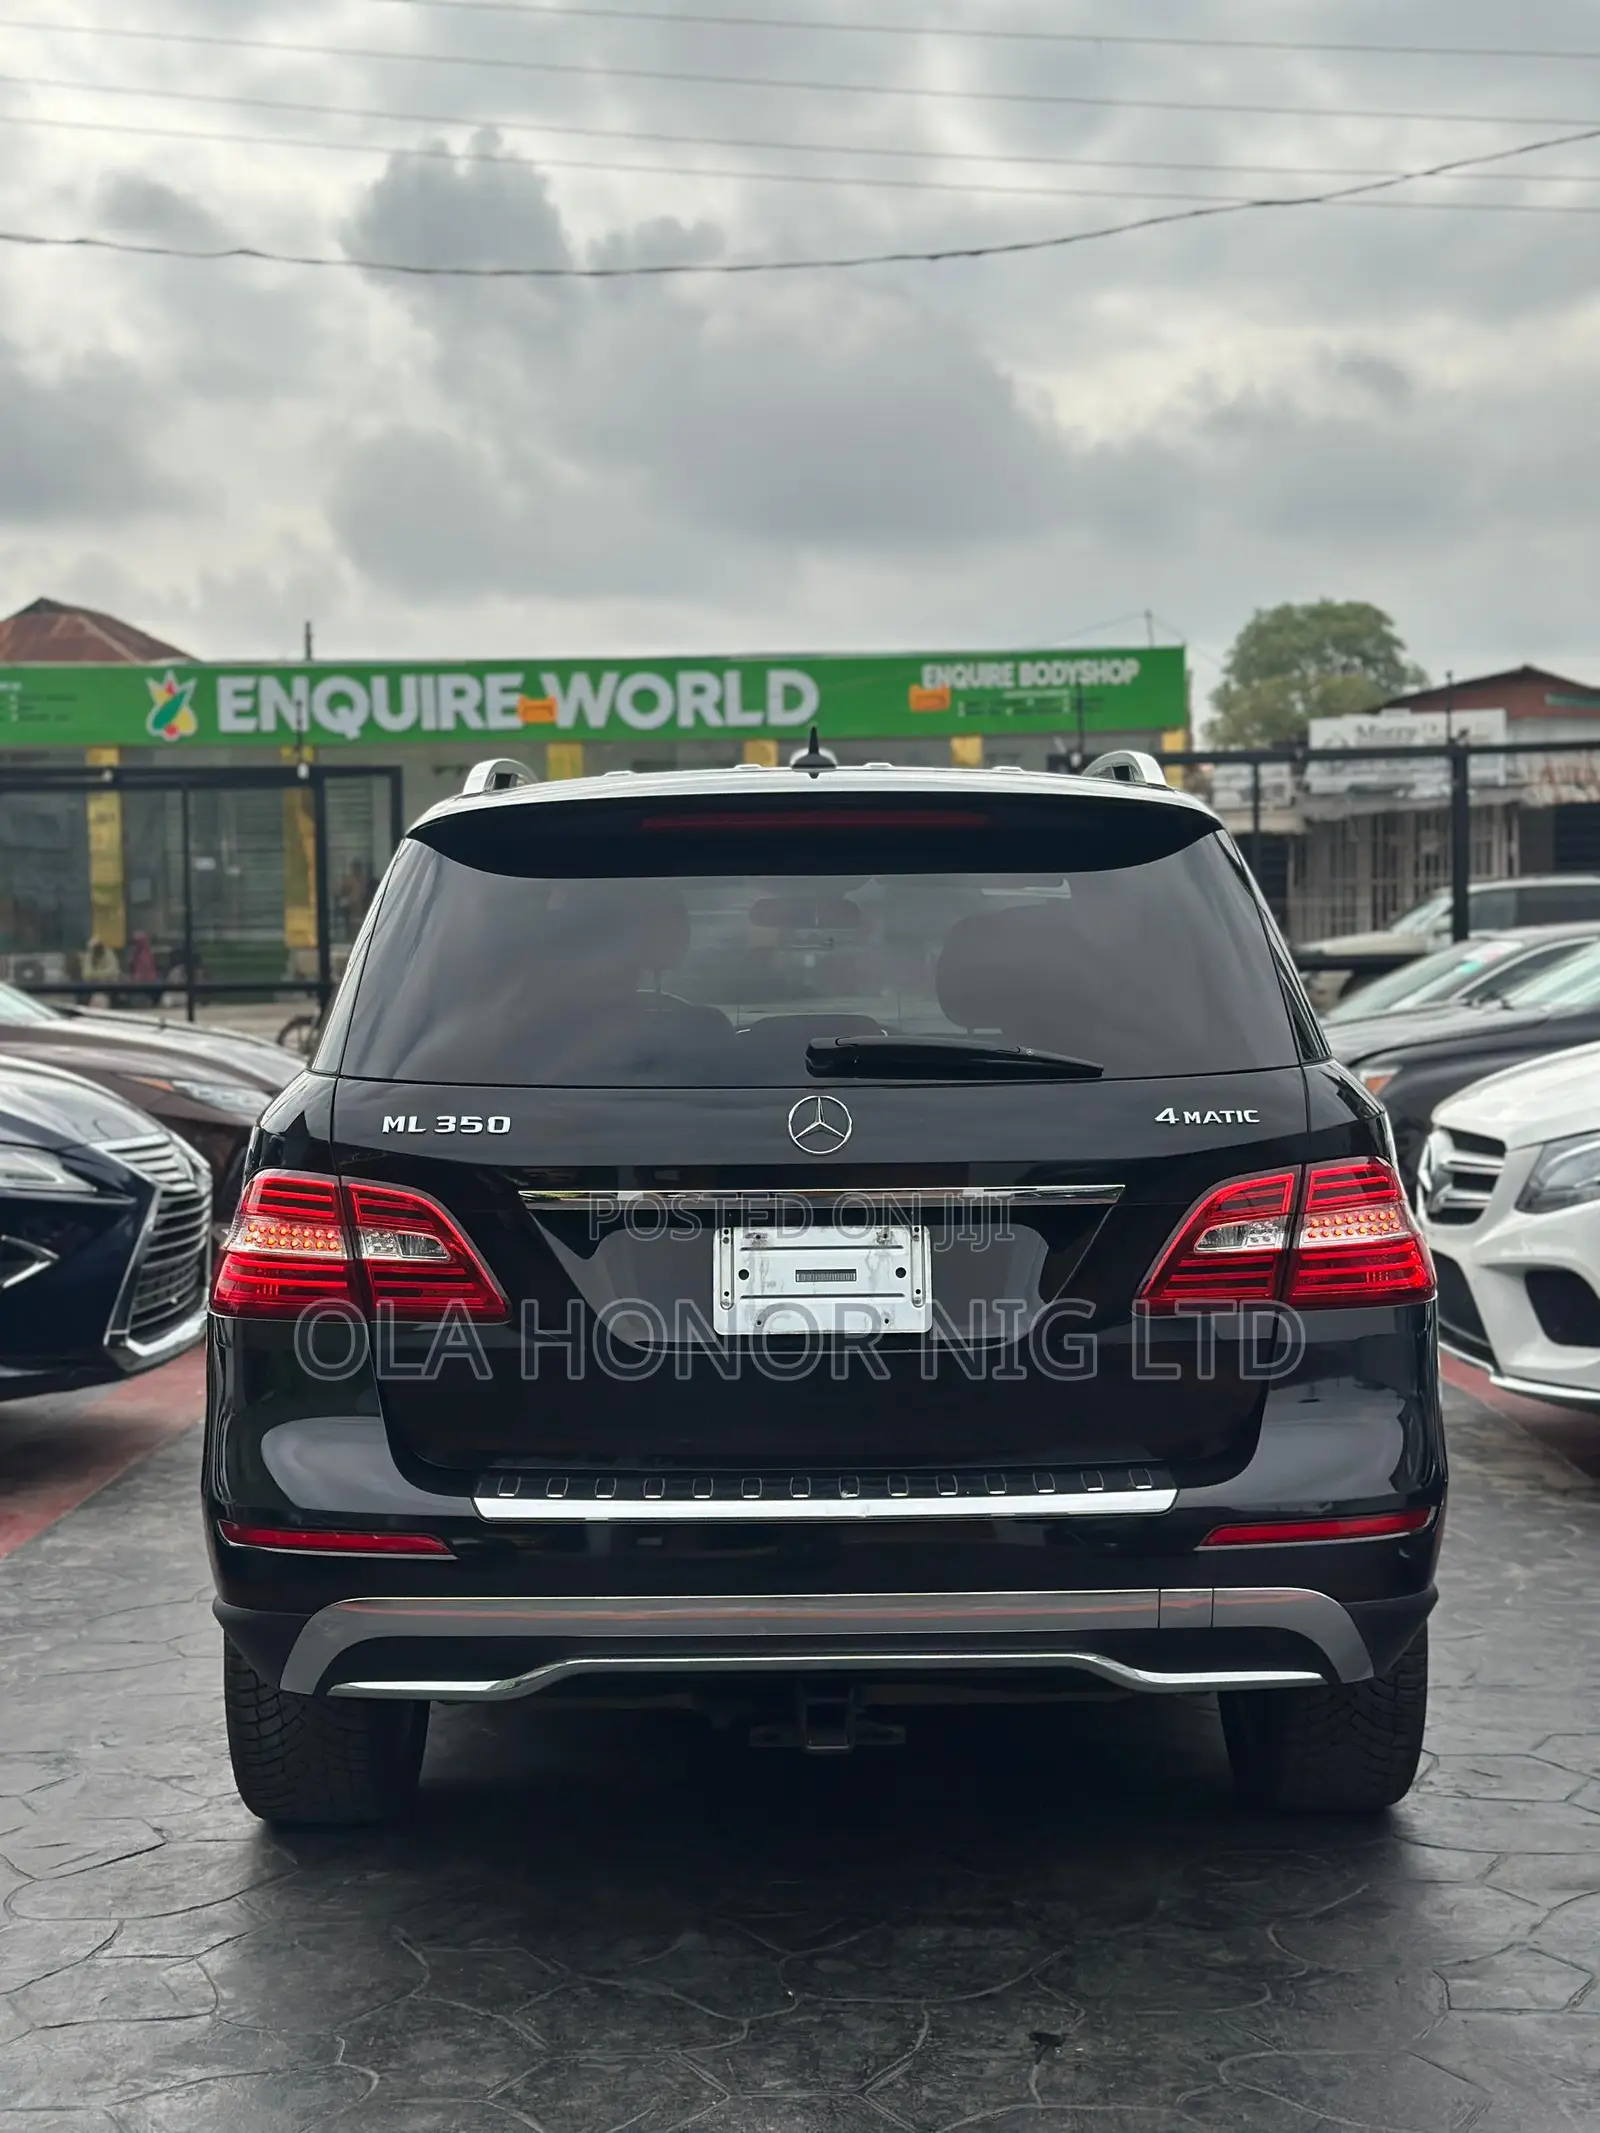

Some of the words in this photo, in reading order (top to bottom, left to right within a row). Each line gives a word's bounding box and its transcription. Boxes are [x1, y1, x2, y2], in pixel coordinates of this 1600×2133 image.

[922, 660, 1015, 690] ENQUIRE
[1018, 657, 1141, 688] BODYSHOP
[217, 672, 524, 740] ENQUIRE
[540, 668, 820, 730] WORLD
[382, 1115, 427, 1134] ML
[433, 1115, 511, 1134] 350
[1154, 1107, 1180, 1125] 4
[1182, 1109, 1261, 1125] MATIC
